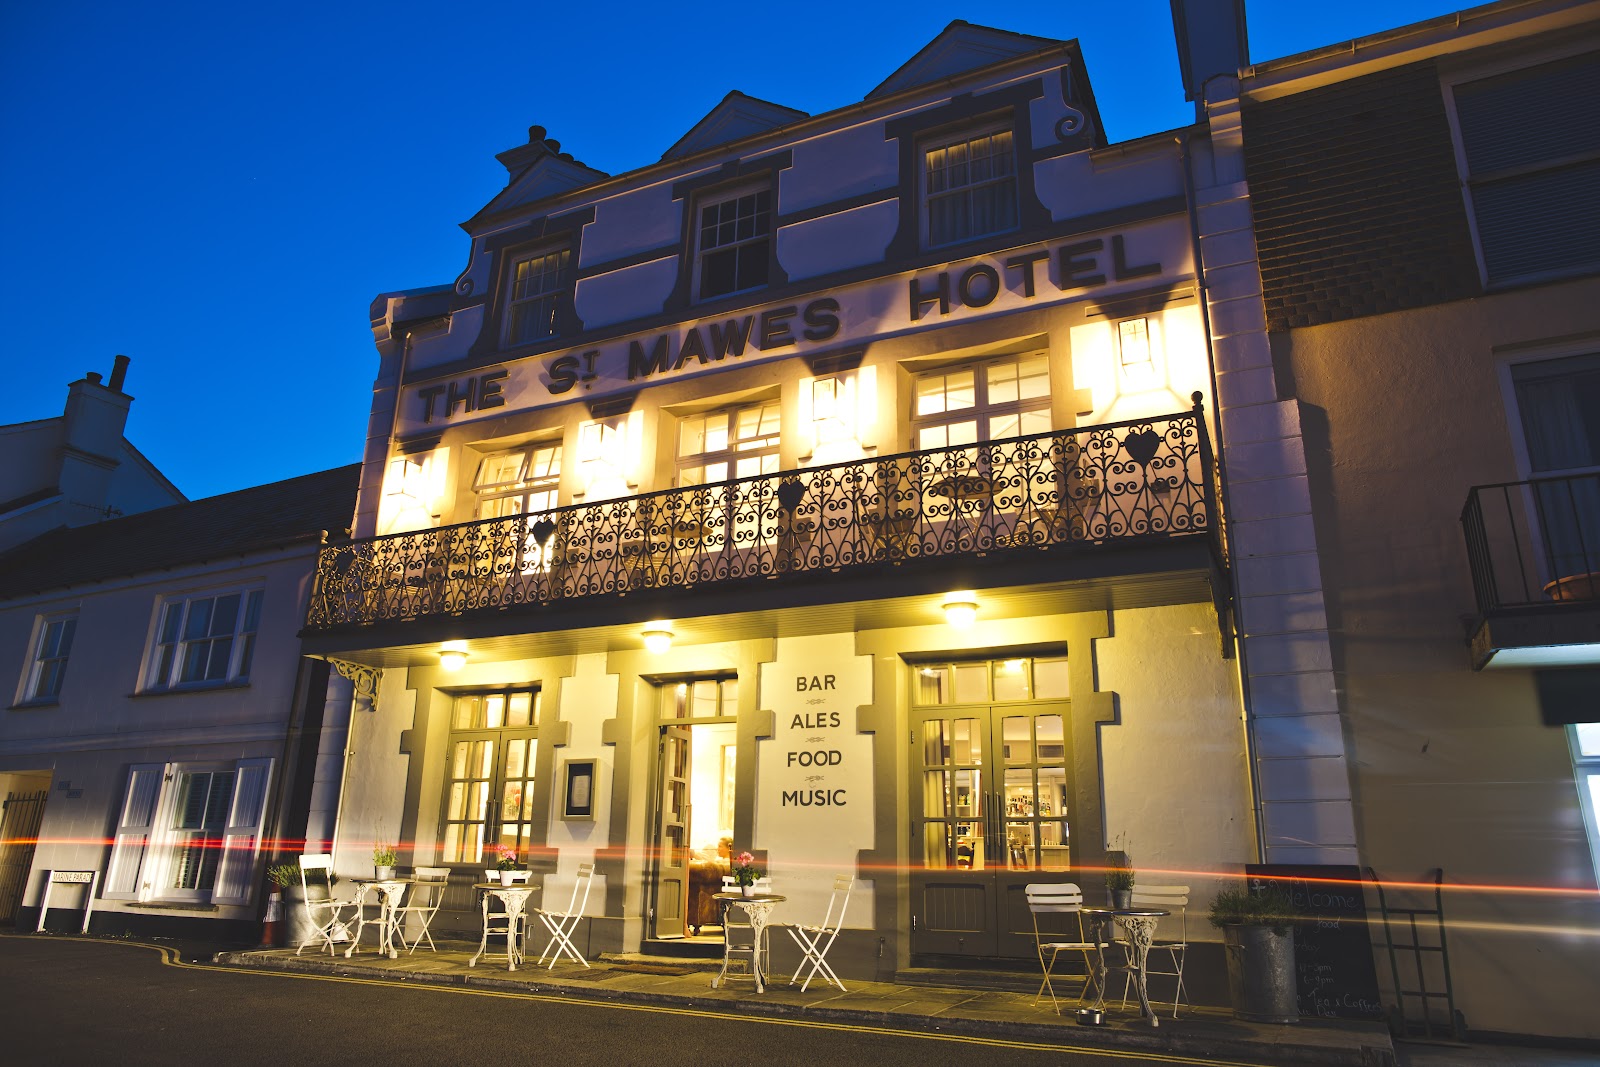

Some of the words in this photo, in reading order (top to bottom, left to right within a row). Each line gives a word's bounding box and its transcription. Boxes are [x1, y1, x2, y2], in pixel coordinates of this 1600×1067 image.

[418, 370, 509, 424] THE
[627, 297, 841, 382] MAWES
[909, 234, 1163, 323] HOTEL
[796, 674, 836, 692] BAR
[790, 711, 841, 729] ALES
[787, 750, 842, 768] FOOD
[782, 789, 847, 807] MUSIC
[53, 873, 73, 882] MARINE
[1269, 876, 1359, 908] Welcome
